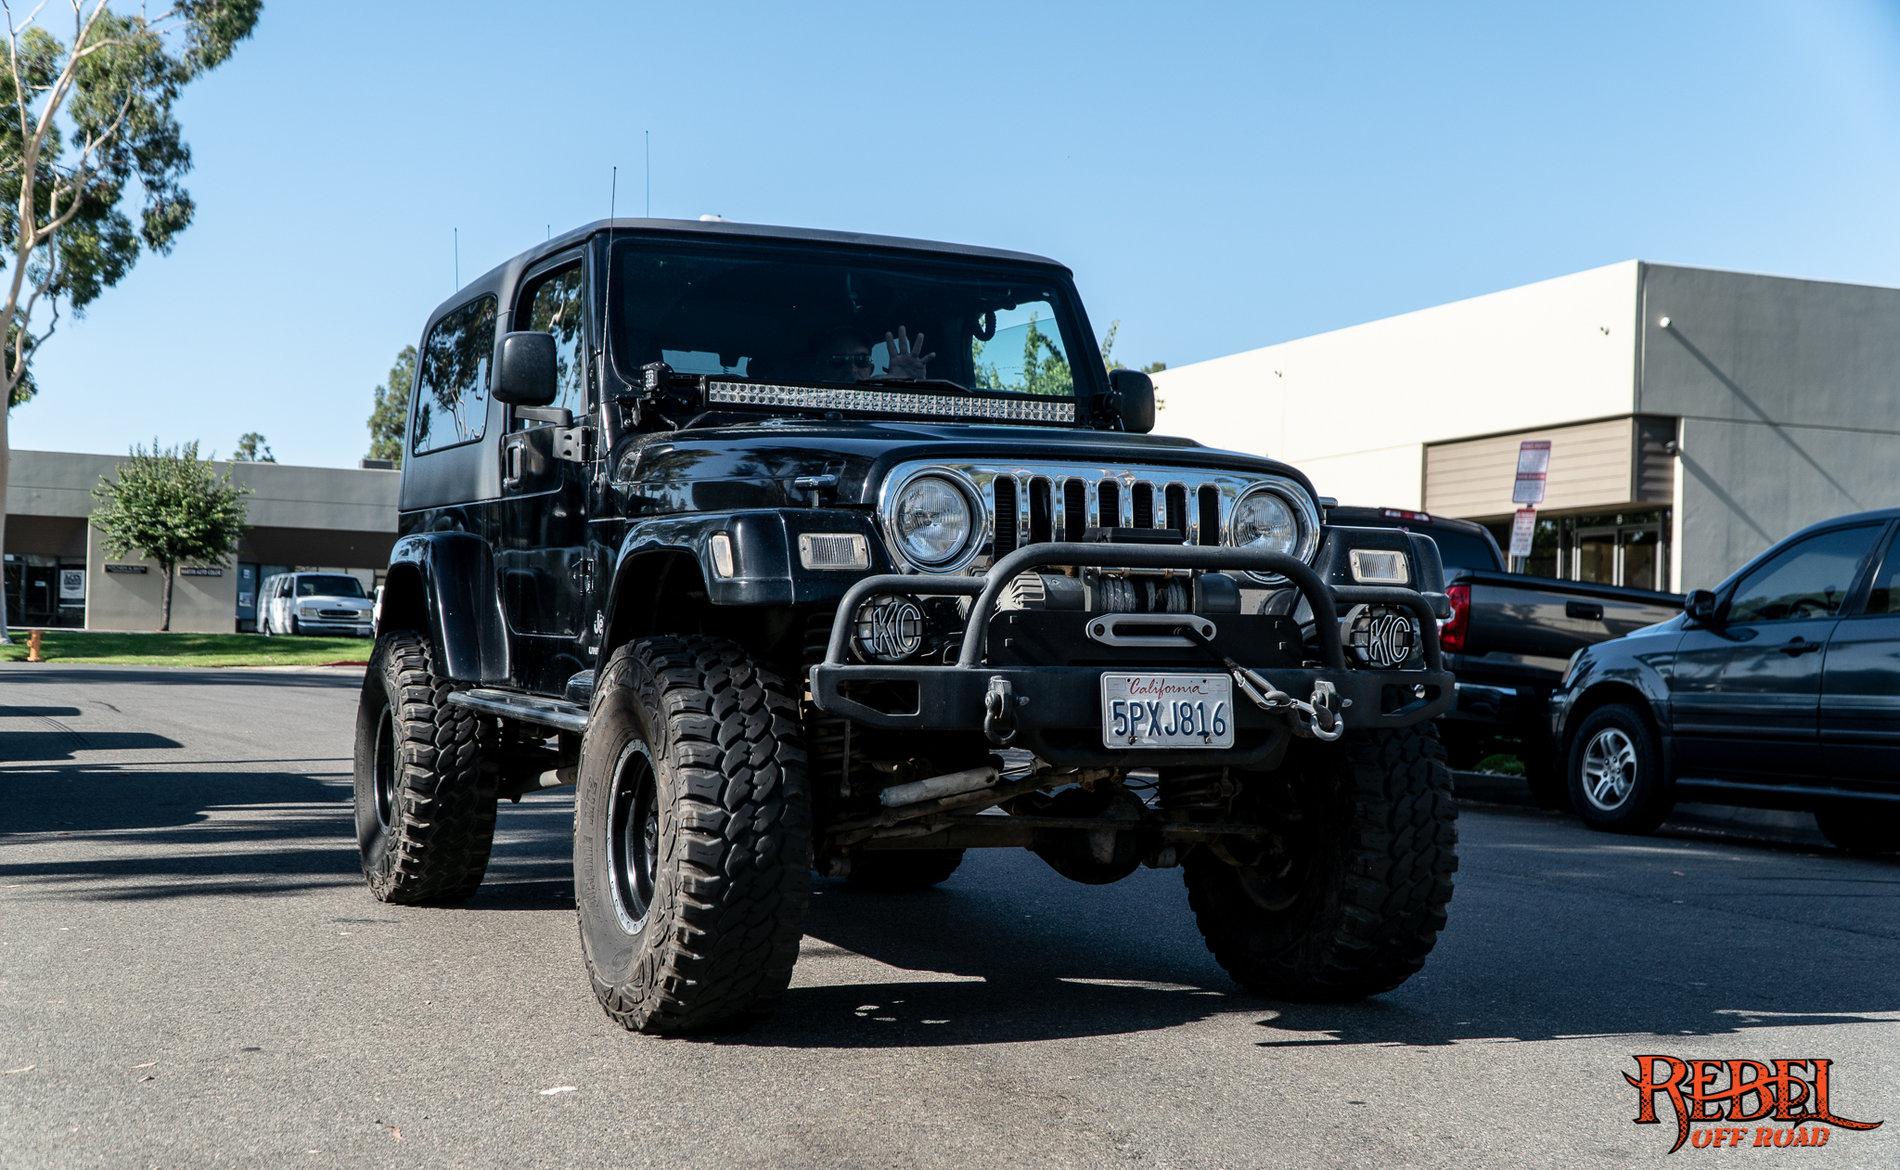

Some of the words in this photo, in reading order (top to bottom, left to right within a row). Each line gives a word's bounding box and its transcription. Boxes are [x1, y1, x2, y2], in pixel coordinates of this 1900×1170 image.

[873, 602, 921, 658] KC
[1370, 614, 1410, 666] KC
[1129, 677, 1208, 699] California
[1111, 701, 1226, 737] 5PXJ816
